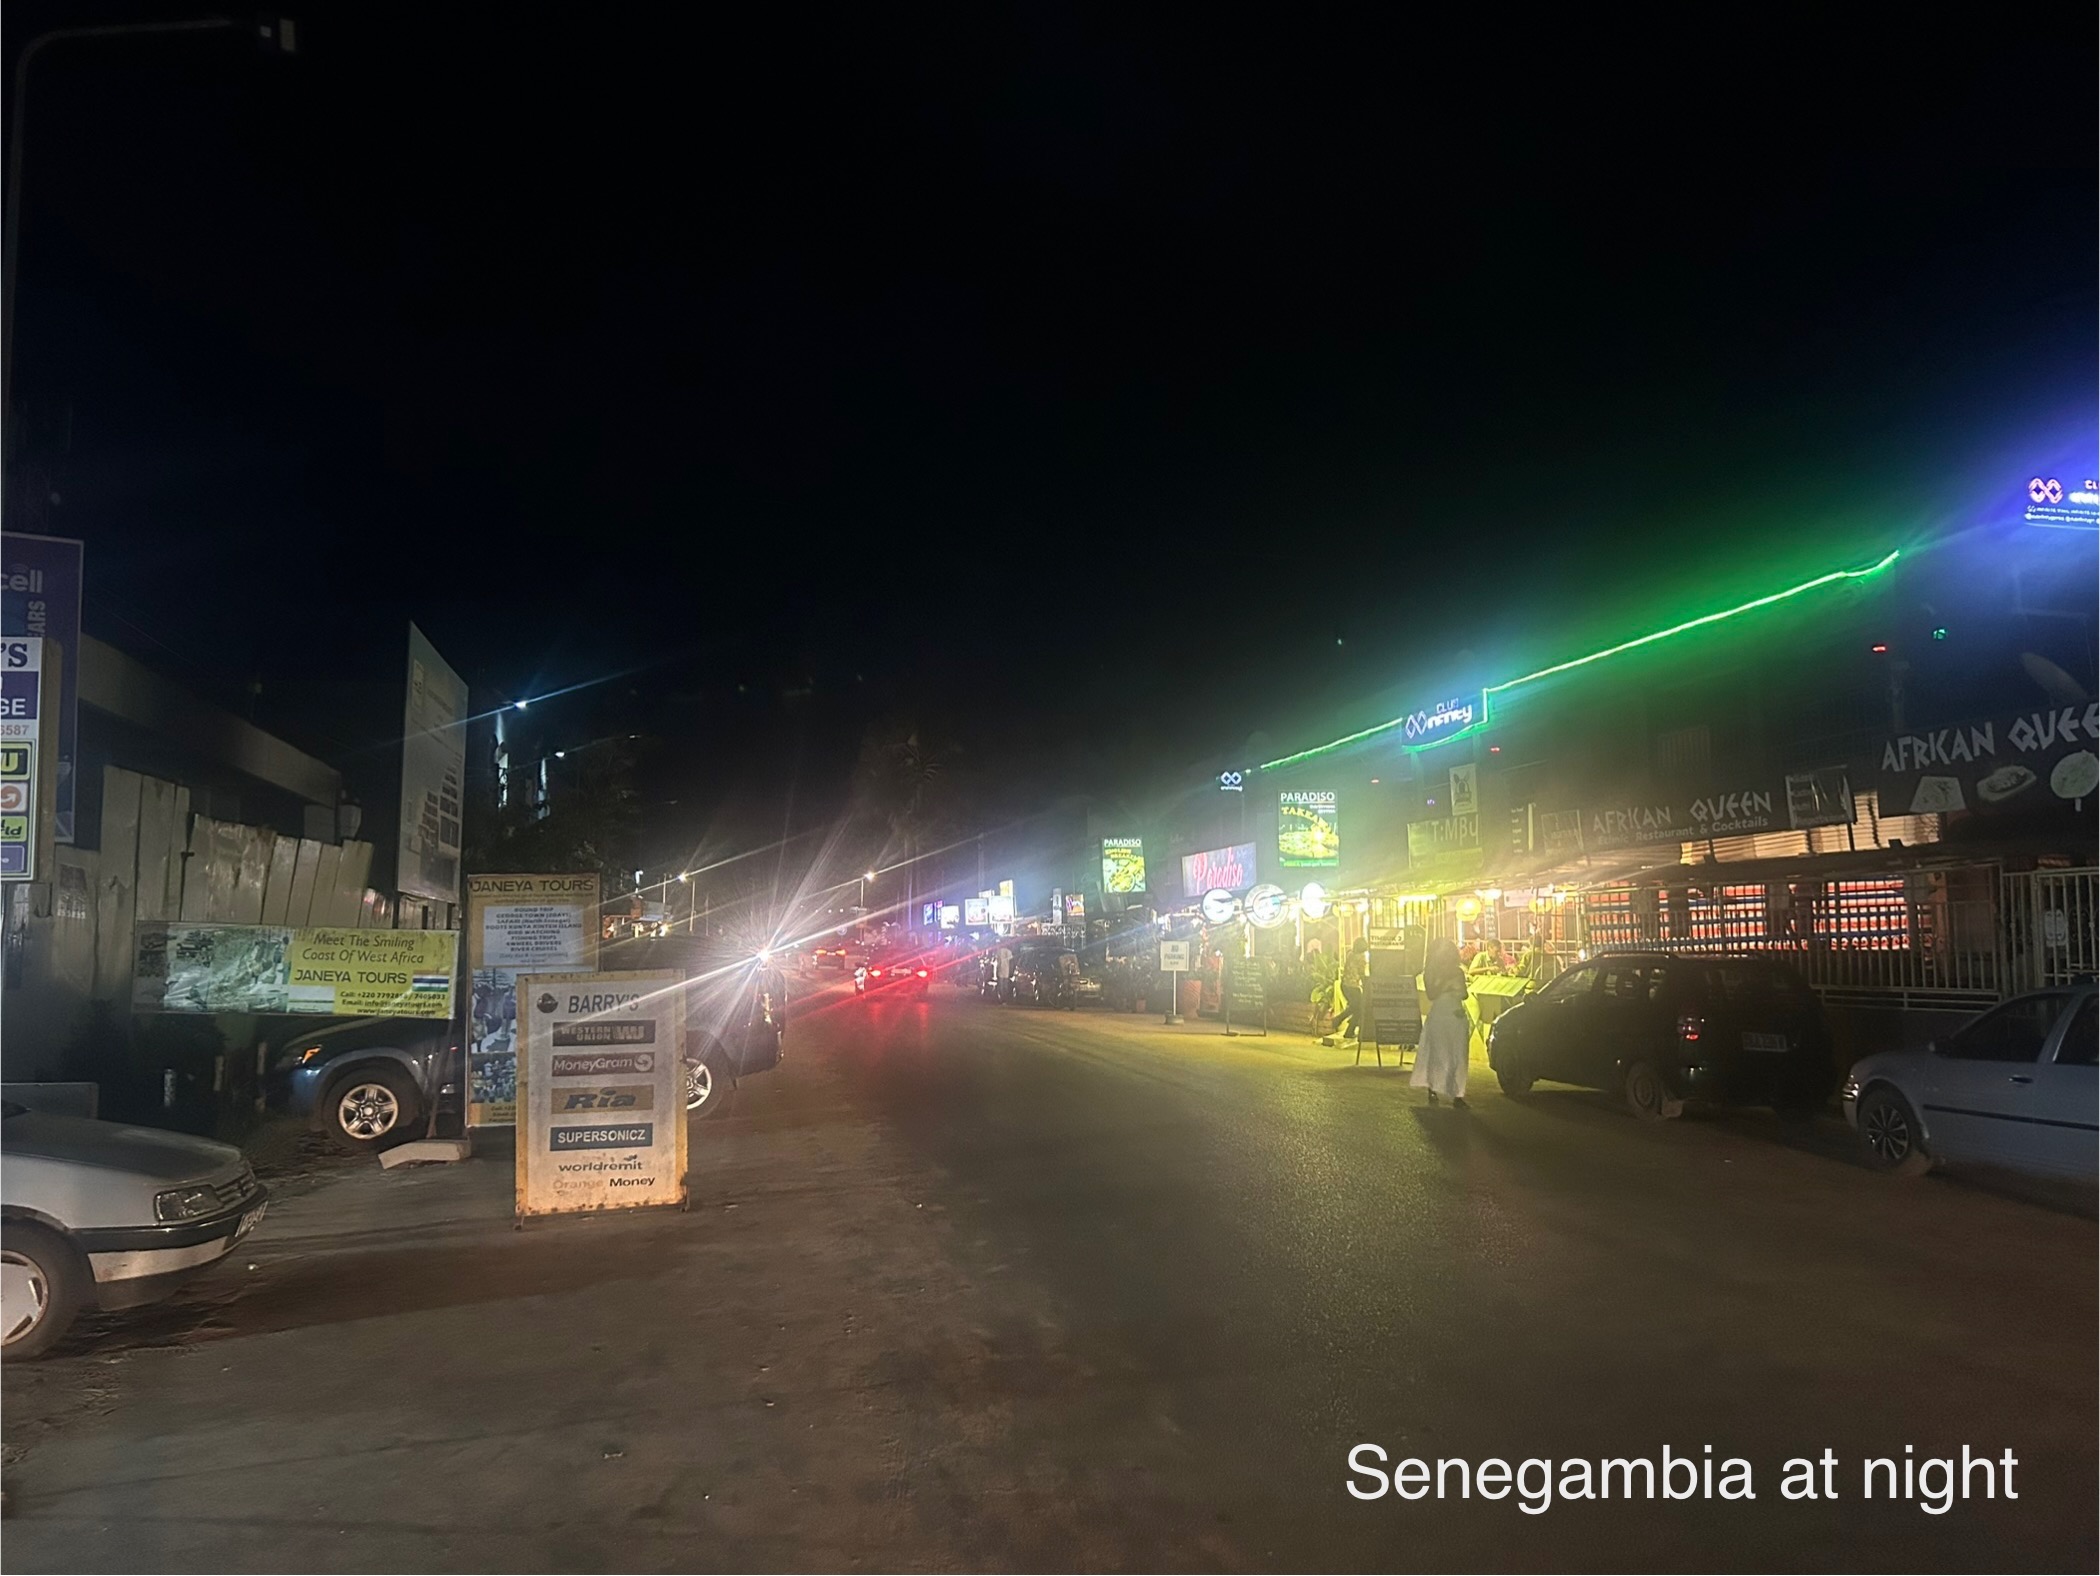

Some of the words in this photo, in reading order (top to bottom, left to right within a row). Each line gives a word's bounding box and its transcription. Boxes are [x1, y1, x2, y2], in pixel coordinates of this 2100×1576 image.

[1280, 792, 1336, 802] PARADISO
[1690, 791, 1772, 822] QUEEN
[1636, 827, 1694, 842] Restaurant
[1700, 824, 1708, 834] &
[1712, 816, 1768, 833] Cocktails
[1104, 838, 1142, 847] PARADISO
[1193, 846, 1243, 895] Paradiso
[472, 880, 533, 892] JANEYA
[539, 879, 594, 891] TOURS
[313, 934, 345, 946] Meet
[350, 934, 370, 947] The
[373, 935, 415, 950] Smiling
[302, 948, 335, 960] Coast
[339, 949, 354, 963] Of
[358, 951, 387, 963] West
[390, 952, 425, 965] Africa
[294, 969, 351, 982] JANEYA
[357, 971, 407, 984] TOURS
[568, 993, 640, 1014] BARRY'S
[561, 1026, 611, 1035] WESTERN
[576, 1033, 611, 1041] UNION
[554, 1058, 632, 1072] MoneyGram
[564, 1087, 636, 1110] Ria
[557, 1129, 646, 1143] SUPERSONICZ
[558, 1160, 643, 1172] worldremit
[609, 1176, 655, 1188] Money
